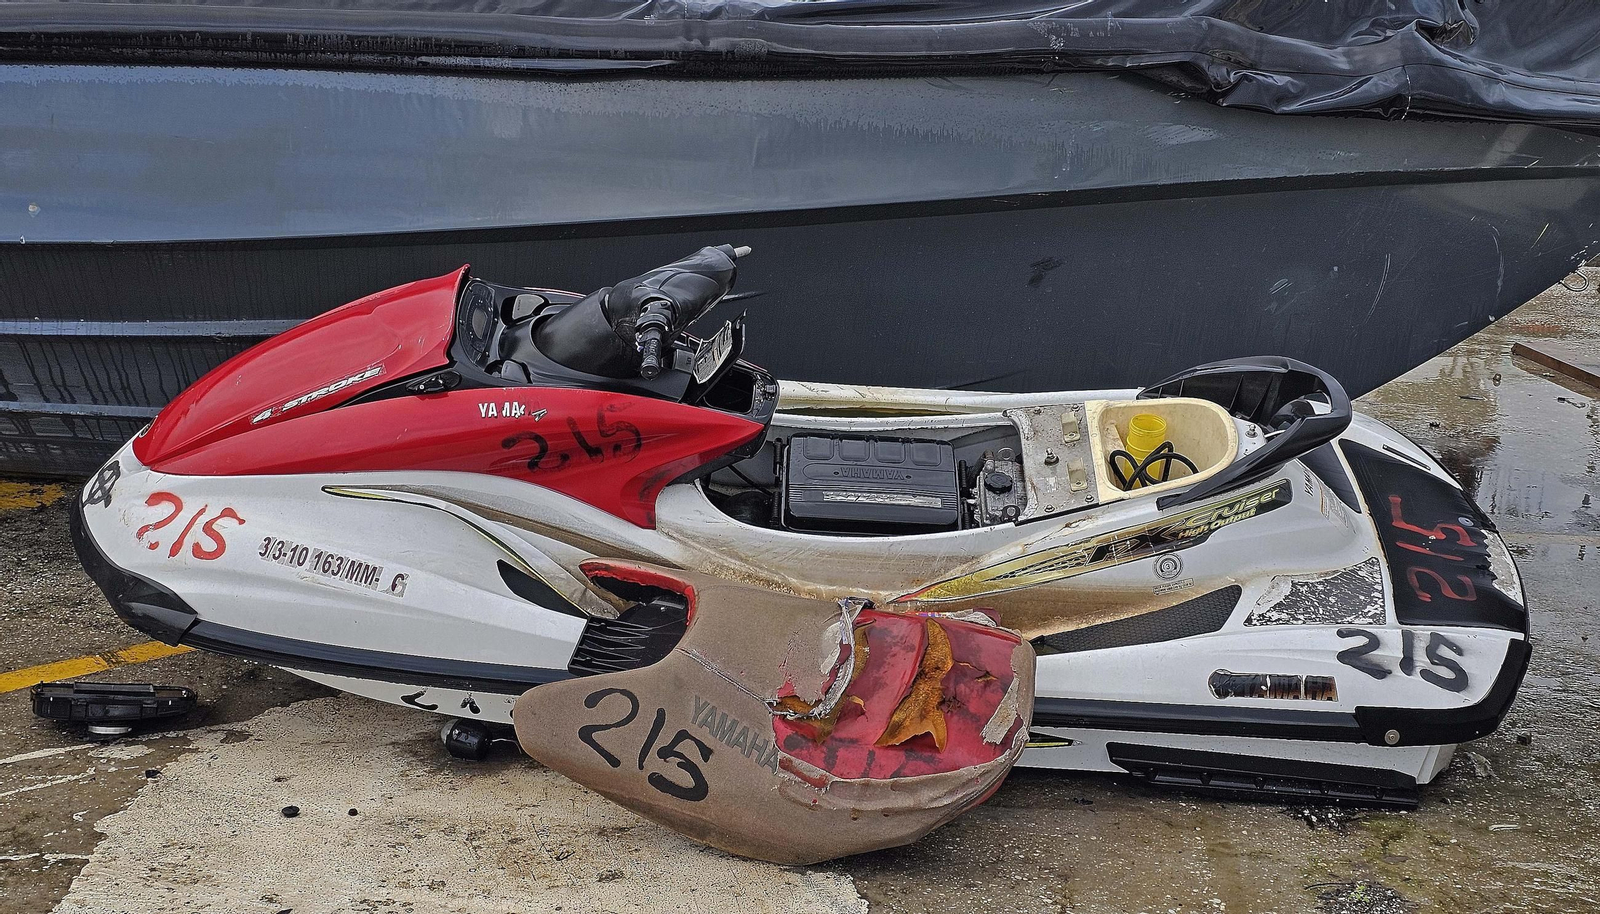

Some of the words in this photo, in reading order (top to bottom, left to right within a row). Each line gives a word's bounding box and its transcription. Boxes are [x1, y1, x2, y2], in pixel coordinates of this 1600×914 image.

[281, 366, 382, 412] STROKE
[501, 401, 642, 472] 215
[840, 466, 905, 480] YAMAHA
[136, 491, 246, 561] 215
[1177, 524, 1210, 541] High
[1210, 507, 1257, 530] Output
[1185, 487, 1279, 528] Cruiser
[258, 536, 310, 567] 3/3-10
[313, 550, 380, 586] 163/MM-
[1387, 494, 1478, 602] 215
[1336, 628, 1469, 693] 215
[578, 687, 714, 802] 215
[690, 694, 780, 775] YAMAHA
